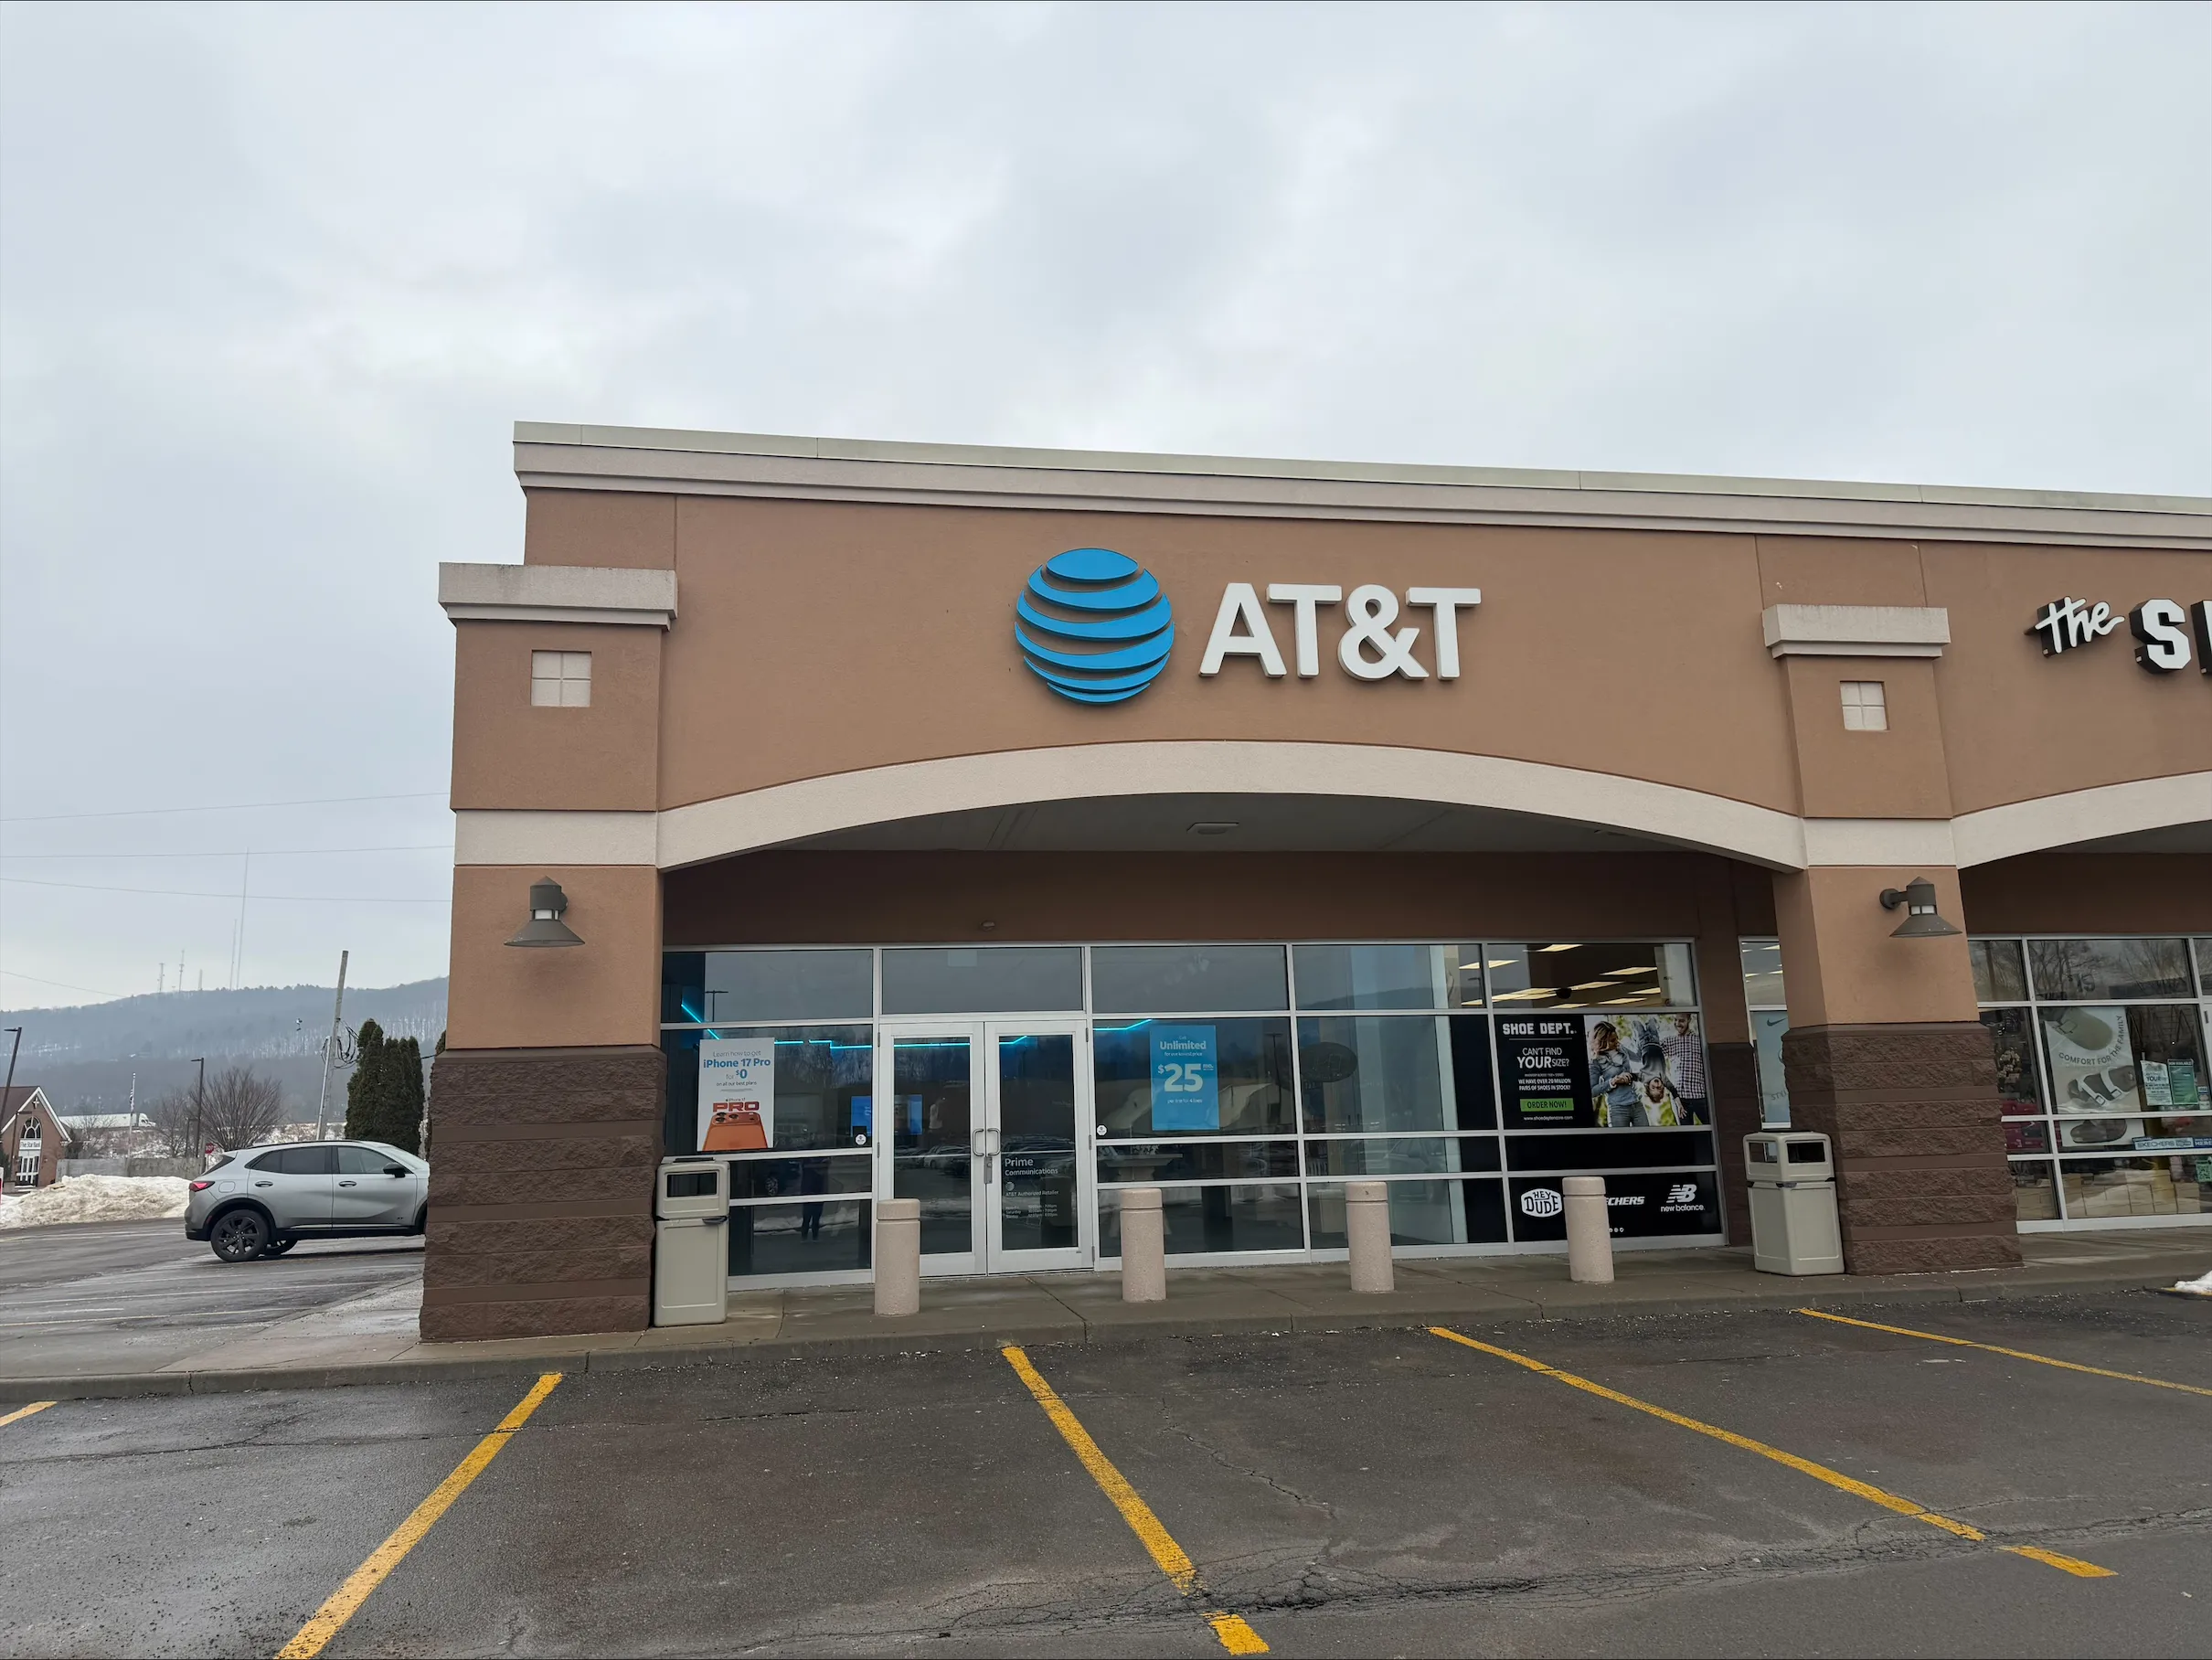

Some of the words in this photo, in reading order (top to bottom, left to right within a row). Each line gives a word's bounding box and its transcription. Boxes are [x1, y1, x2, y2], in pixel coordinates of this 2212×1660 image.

[1198, 582, 1481, 681] AT&T
[2034, 596, 2125, 654] the
[2137, 599, 2212, 672] S
[1502, 1023, 1535, 1035] SHOE
[1539, 1022, 1575, 1035] DEPT.
[1160, 1040, 1207, 1050] Unlimited
[2058, 1052, 2096, 1065] COMFORT
[2097, 1055, 2112, 1065] FOR
[2110, 1045, 2122, 1057] THE
[2116, 1015, 2125, 1045] FAMILY
[1522, 1048, 1544, 1056] CAN'T
[1545, 1047, 1562, 1055] FIND
[703, 1059, 739, 1069] iPhone
[740, 1059, 751, 1067] 17
[753, 1058, 771, 1067] Pro
[1517, 1056, 1552, 1069] YOUR
[1551, 1058, 1569, 1067] SIZE?
[735, 1069, 748, 1079] $0
[1157, 1062, 1204, 1092] $25
[713, 1101, 760, 1112] PRO
[1526, 1101, 1548, 1109] ORDER
[2137, 1140, 2175, 1148] SKECHERS
[1005, 1157, 1034, 1167] Prime
[1005, 1167, 1058, 1176] Communications
[1532, 1190, 1551, 1200] HEY
[1524, 1195, 1559, 1214] DUDE
[1605, 1196, 1645, 1207] CHERS
